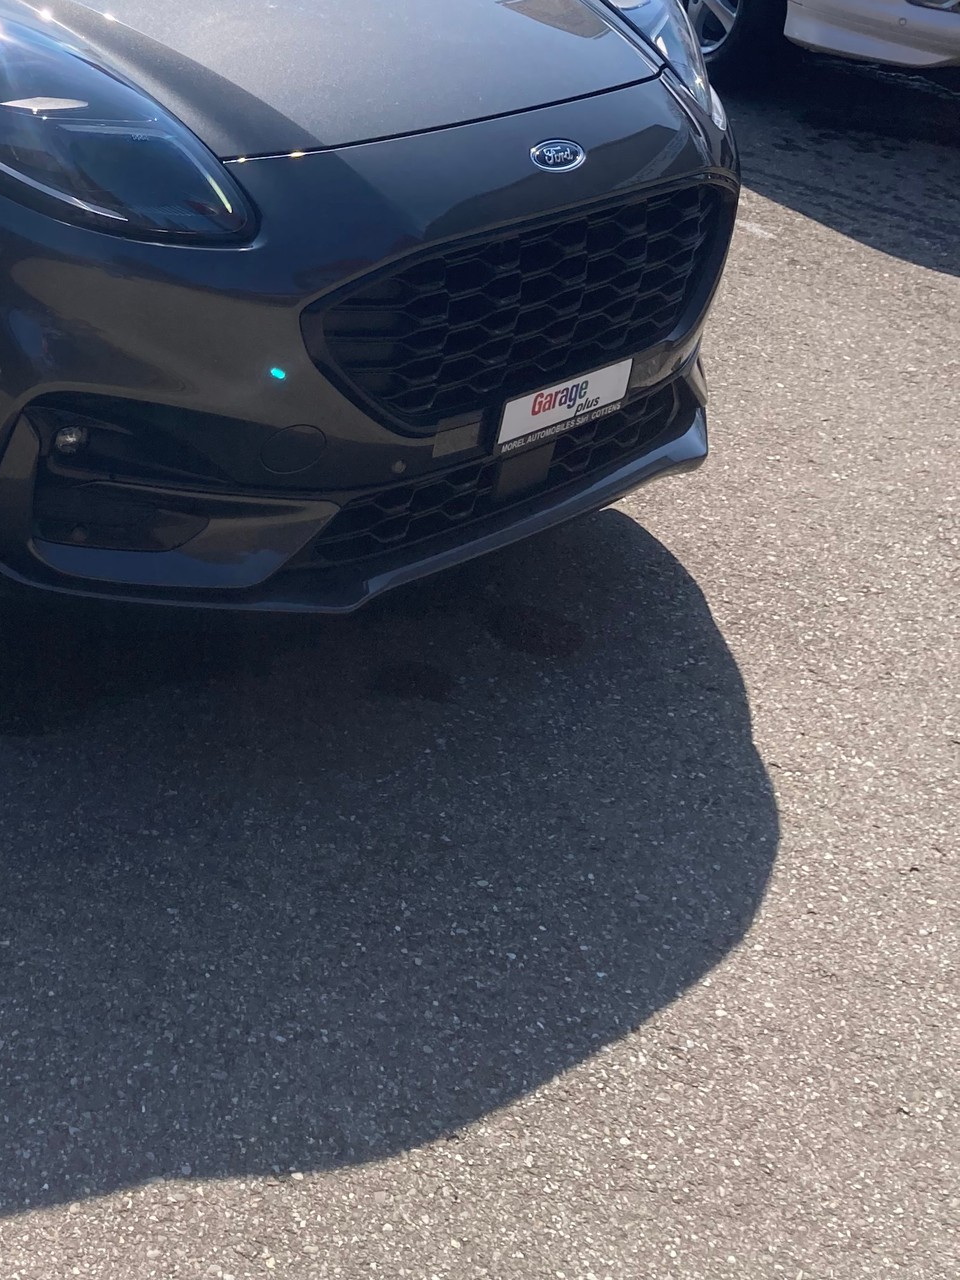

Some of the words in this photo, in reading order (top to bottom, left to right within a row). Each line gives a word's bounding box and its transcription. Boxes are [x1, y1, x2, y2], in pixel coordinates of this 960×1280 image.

[543, 146, 574, 165] Ford
[531, 380, 589, 416] Garage
[575, 396, 600, 416] plus
[501, 439, 526, 453] MOREL
[526, 421, 575, 442] AUTOMOBILES
[591, 402, 621, 419] COTTENS
